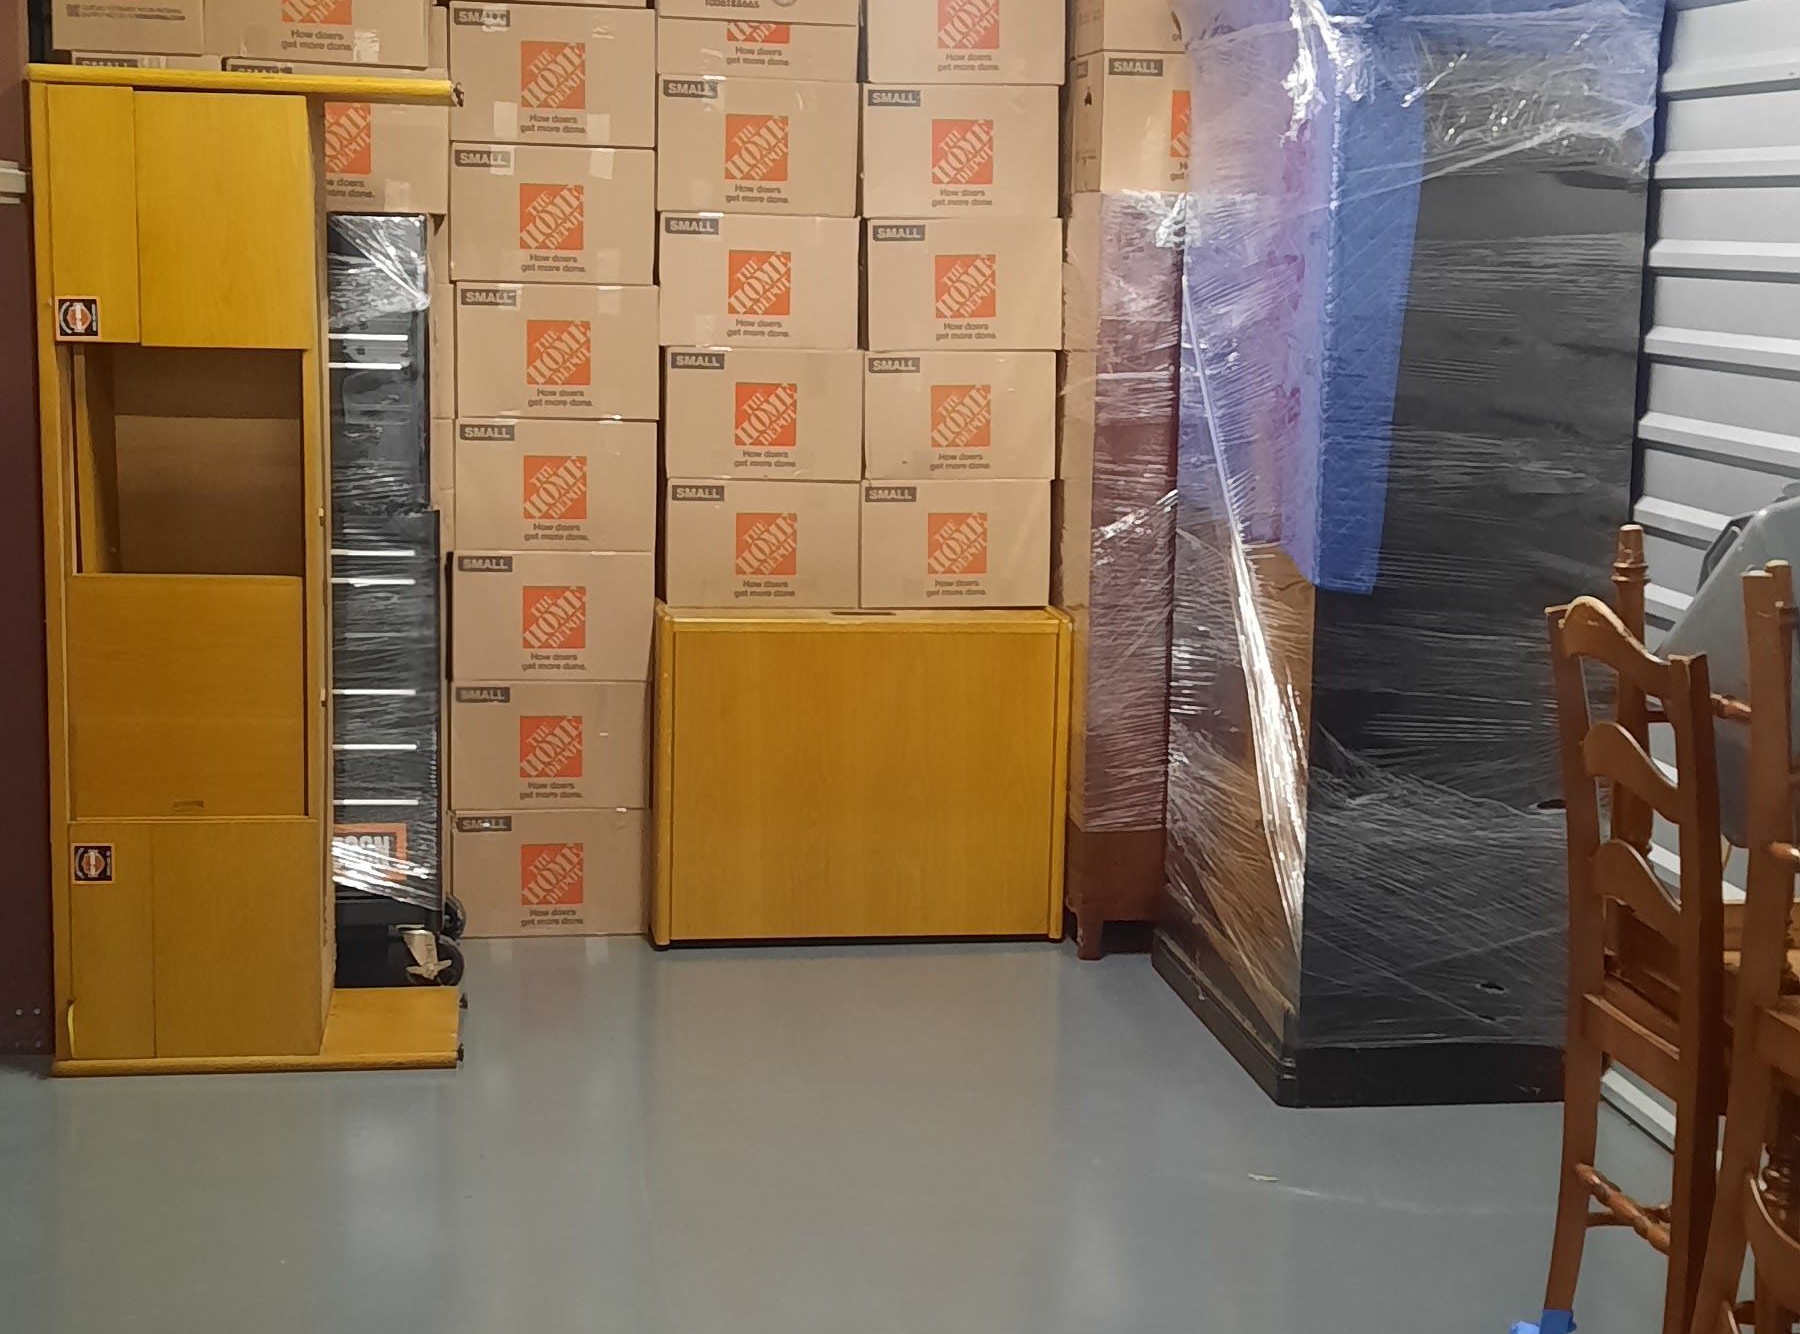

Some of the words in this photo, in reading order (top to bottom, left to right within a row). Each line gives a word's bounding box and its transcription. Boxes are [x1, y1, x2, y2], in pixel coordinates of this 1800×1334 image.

[962, 9, 999, 48] DEPOT
[522, 43, 585, 108] HOME
[1114, 61, 1157, 73] SMALL
[547, 69, 585, 108] DEPOT
[668, 83, 714, 95] SMALL
[873, 92, 917, 104] SMALL
[460, 153, 506, 165] SMALL
[726, 116, 788, 180] HOME
[750, 141, 788, 180] DEPOT
[932, 121, 993, 183] HOME
[956, 145, 993, 184] DEPOT
[520, 185, 583, 249] HOME
[545, 210, 583, 249] DEPOT
[670, 219, 714, 232] SMALL
[877, 227, 920, 239] SMALL
[729, 252, 791, 314] HOME
[753, 276, 790, 314] DEPOT
[936, 256, 996, 318] HOME
[959, 280, 996, 318] DEPOT
[527, 322, 591, 384] HOME
[552, 346, 591, 384] DEPOT
[676, 355, 719, 366] SMALL
[873, 360, 916, 371] SMALL
[464, 427, 510, 438] SMALL
[736, 384, 797, 445] HOME
[760, 408, 797, 445] DEPOT
[931, 386, 991, 446] HOME
[955, 410, 991, 446] DEPOT
[524, 457, 587, 518] HOME
[549, 481, 587, 518] DEPOT
[676, 487, 720, 499] SMALL
[869, 489, 912, 500] SMALL
[736, 514, 797, 575] HOME
[760, 538, 797, 575] DEPOT
[928, 514, 987, 573] HOME
[951, 537, 987, 573] DEPOT
[463, 559, 508, 569] SMALL
[523, 587, 586, 648] HOME
[548, 611, 586, 648] DEPOT
[521, 717, 582, 777] HOME
[545, 740, 582, 777] DEPOT
[522, 845, 583, 904] HOME
[546, 868, 583, 904] DEPOT
